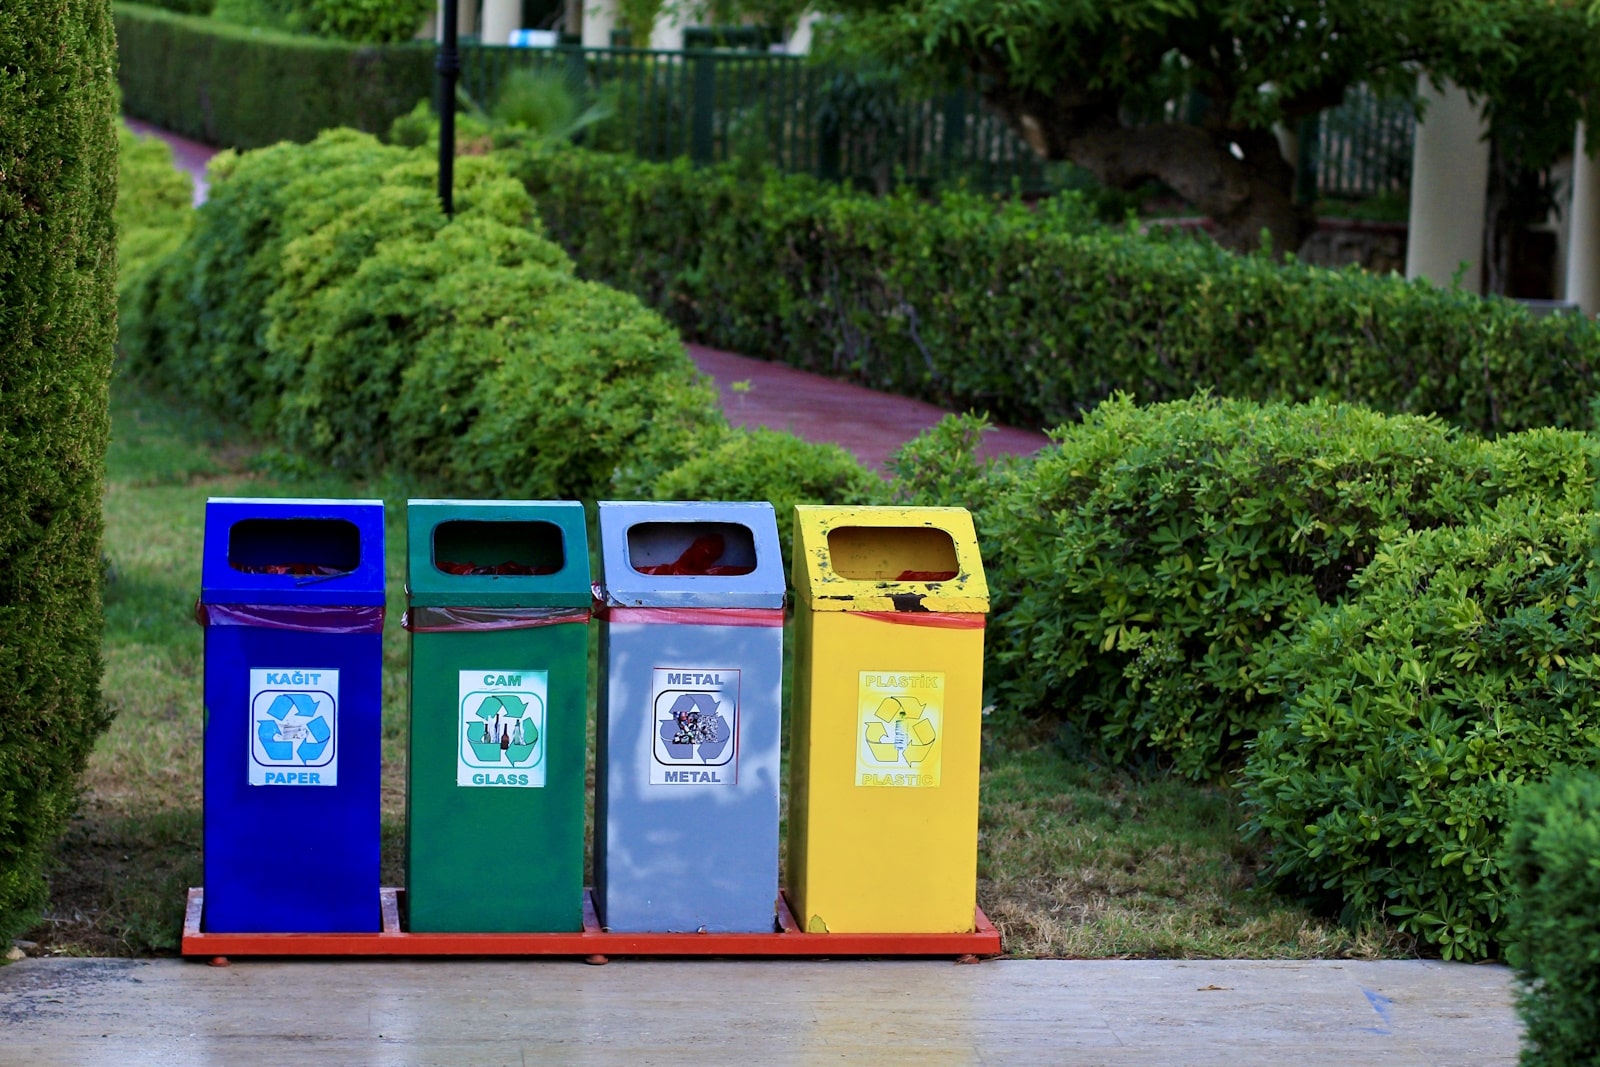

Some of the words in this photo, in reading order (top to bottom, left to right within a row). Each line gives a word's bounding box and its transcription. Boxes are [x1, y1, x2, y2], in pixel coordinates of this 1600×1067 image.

[267, 670, 321, 685] KAĞIT
[483, 674, 522, 687] CAM
[667, 673, 724, 685] METAL
[865, 673, 938, 688] PLASTİK
[265, 772, 320, 784] PAPER
[472, 773, 529, 786] GLASS
[664, 771, 721, 783] METAL
[861, 773, 934, 786] PLASTIC
